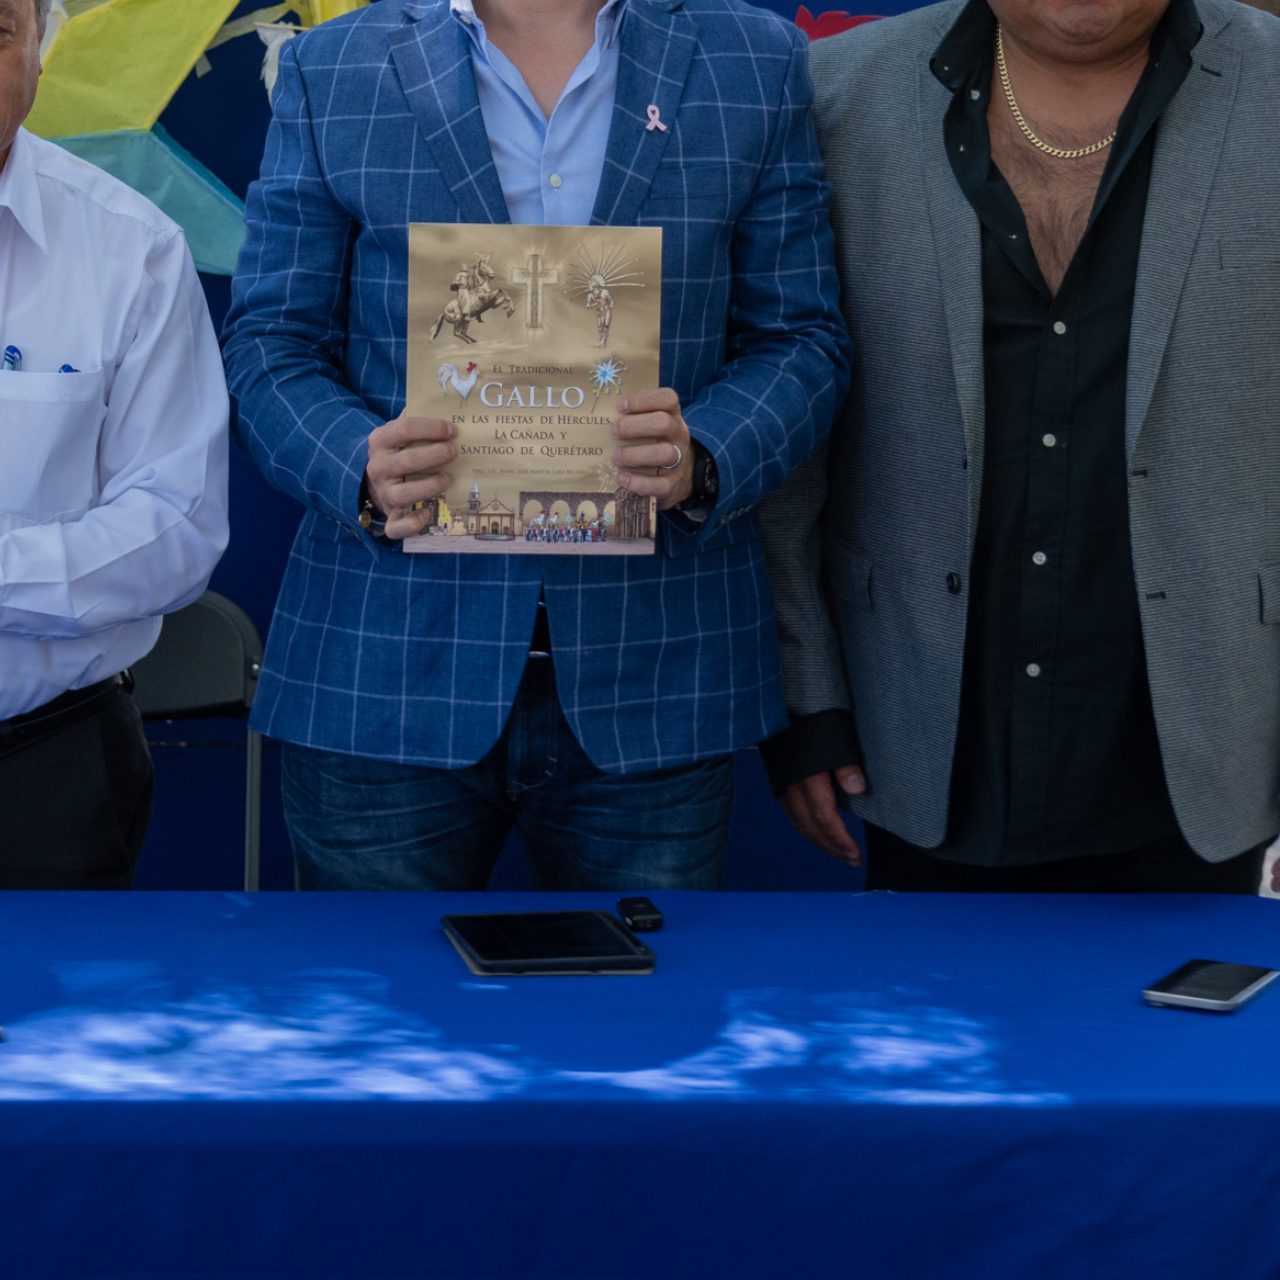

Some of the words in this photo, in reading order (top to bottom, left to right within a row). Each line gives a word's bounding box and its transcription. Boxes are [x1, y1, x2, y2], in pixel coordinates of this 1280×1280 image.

[480, 381, 585, 409] GALLO
[451, 415, 465, 424] EN
[471, 415, 489, 424] LAS
[495, 415, 534, 424] FIESTAS
[540, 415, 554, 425] DE
[560, 431, 567, 440] Y
[460, 445, 514, 456] SANTIAGO
[520, 446, 534, 456] DE
[540, 444, 603, 457] QUERÉTARO
